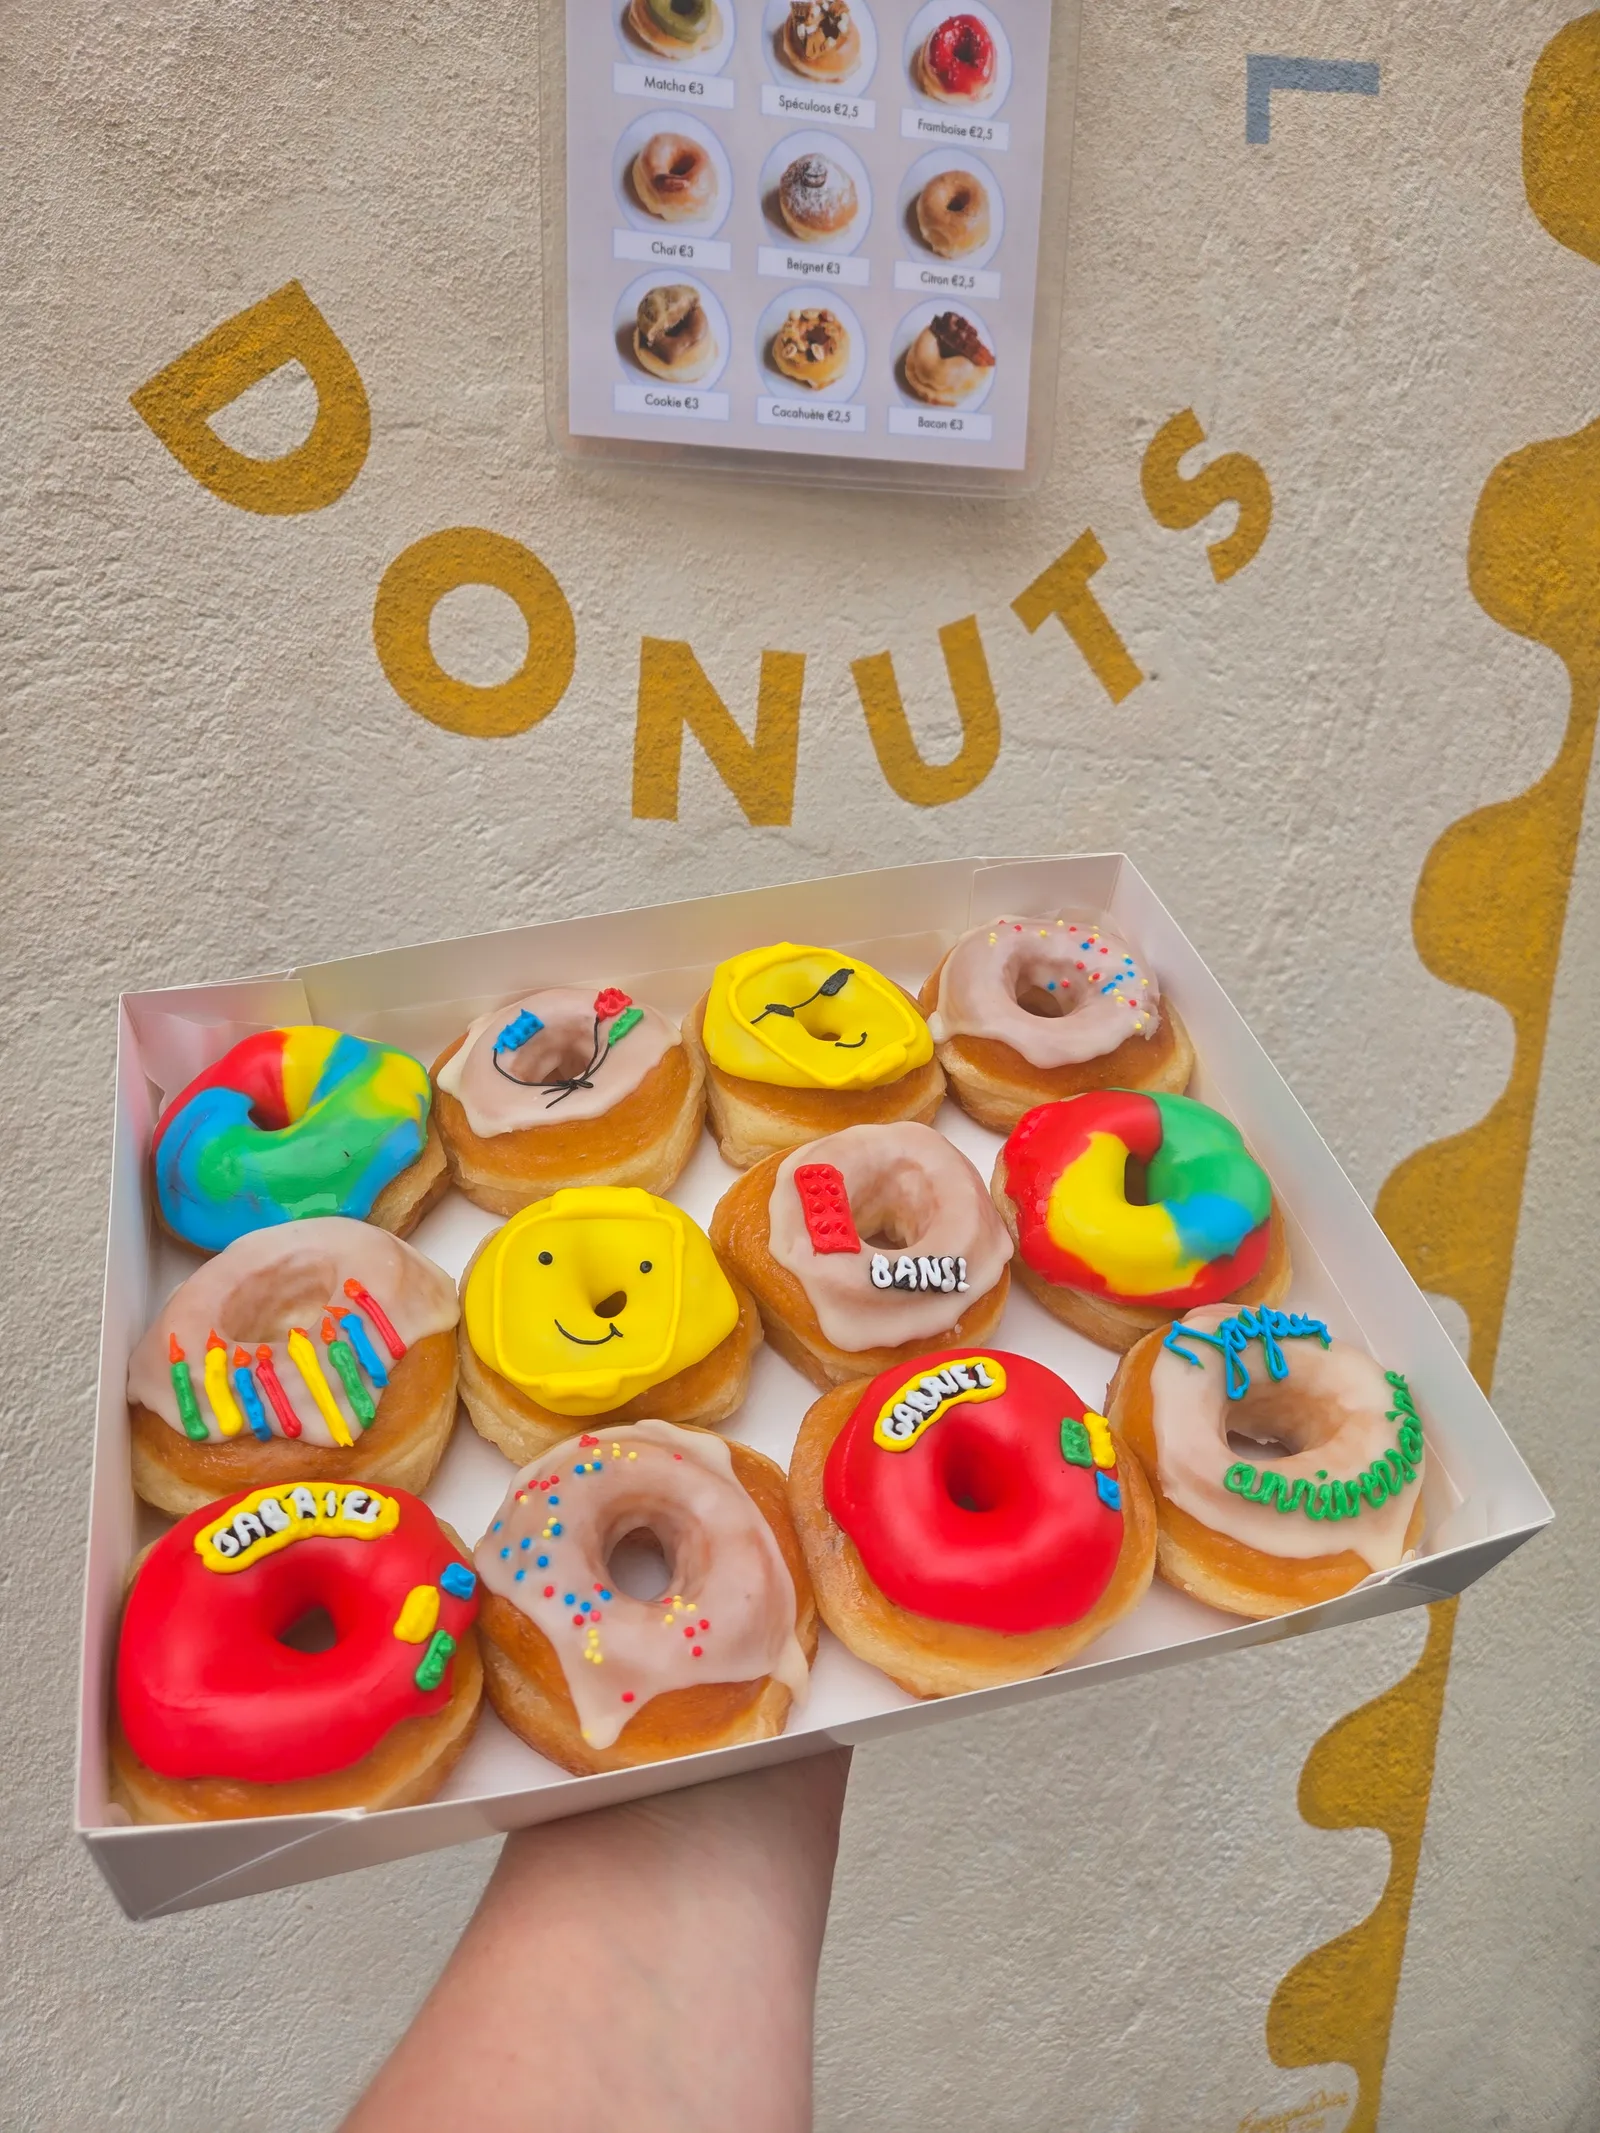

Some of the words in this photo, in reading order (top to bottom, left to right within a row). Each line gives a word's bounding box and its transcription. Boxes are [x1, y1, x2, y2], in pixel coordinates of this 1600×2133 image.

[644, 76, 686, 93] Matcha
[688, 82, 704, 95] €3
[778, 95, 831, 114] Spéculoos
[833, 104, 859, 118] €2,5
[917, 118, 967, 136] Framboise
[969, 126, 993, 141] €2,5
[651, 241, 676, 257] Chaï
[678, 246, 694, 258] €3
[786, 258, 825, 274] Beignet
[826, 262, 841, 275] €3
[920, 271, 949, 285] Citron
[951, 275, 975, 289] €2,5
[644, 394, 682, 408] Cookie
[684, 397, 699, 410] €3
[771, 405, 825, 421] Cacahuète
[827, 410, 851, 424] €2,5
[917, 416, 947, 429] Bacon
[949, 419, 964, 431] €3
[129, 280, 1273, 826] DONUTS
